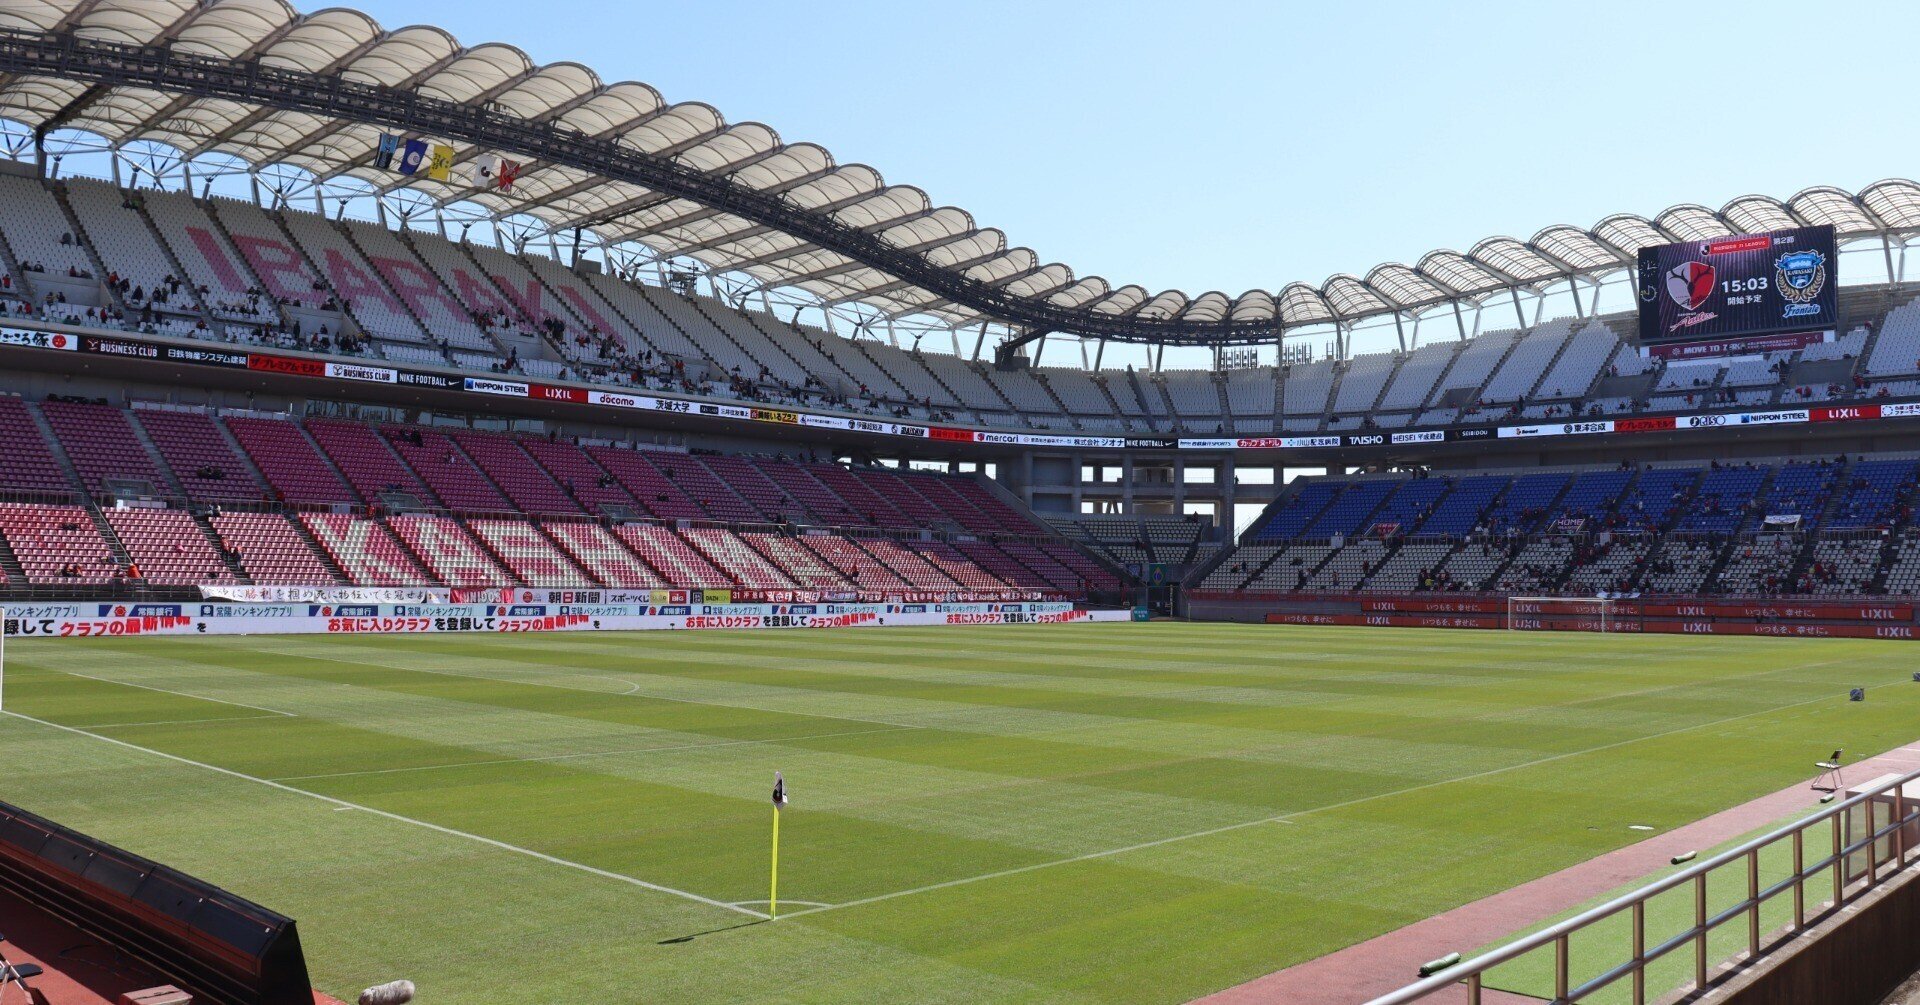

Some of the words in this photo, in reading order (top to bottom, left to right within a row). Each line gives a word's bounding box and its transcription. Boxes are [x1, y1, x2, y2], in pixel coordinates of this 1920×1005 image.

[1721, 277, 1768, 293] 15:03
[1727, 294, 1762, 305] 開始予定
[0, 331, 49, 347] ごころ豚
[100, 343, 137, 355] BUSINESS
[138, 347, 158, 357] CLUB
[343, 369, 374, 380] BUSINESS
[374, 372, 390, 381] CLUB
[400, 374, 414, 384] NIKE
[415, 374, 446, 387] FOOTBALL
[474, 381, 503, 392] NIPPON
[504, 384, 528, 394] STEEL
[545, 388, 572, 399] LIXIL
[600, 395, 635, 406] docomo
[655, 400, 690, 412] 茨城大学
[1751, 414, 1781, 422] NIPPON
[1782, 412, 1808, 420] STEEL
[1828, 408, 1860, 418] LIXIL
[985, 434, 1019, 443] mercari
[1126, 439, 1138, 447] NIKE
[1349, 436, 1384, 445] TAISHO
[1392, 434, 1416, 442] HEISEI
[548, 591, 601, 603] 朝日新聞
[610, 594, 650, 603] スポーツくじ
[1373, 602, 1396, 610] LIXIL
[1516, 604, 1542, 613] LIXIL
[1677, 606, 1706, 616] LIXIL
[5, 606, 79, 618] バンキングアプリ
[216, 606, 292, 617] 常陽バンキングアプリ
[1861, 609, 1895, 619] LIXIL
[1366, 615, 1391, 624] LIXIL
[1515, 619, 1541, 628] LIXIL
[1683, 623, 1713, 633] LIXIL
[1877, 627, 1912, 637] LIXIL
